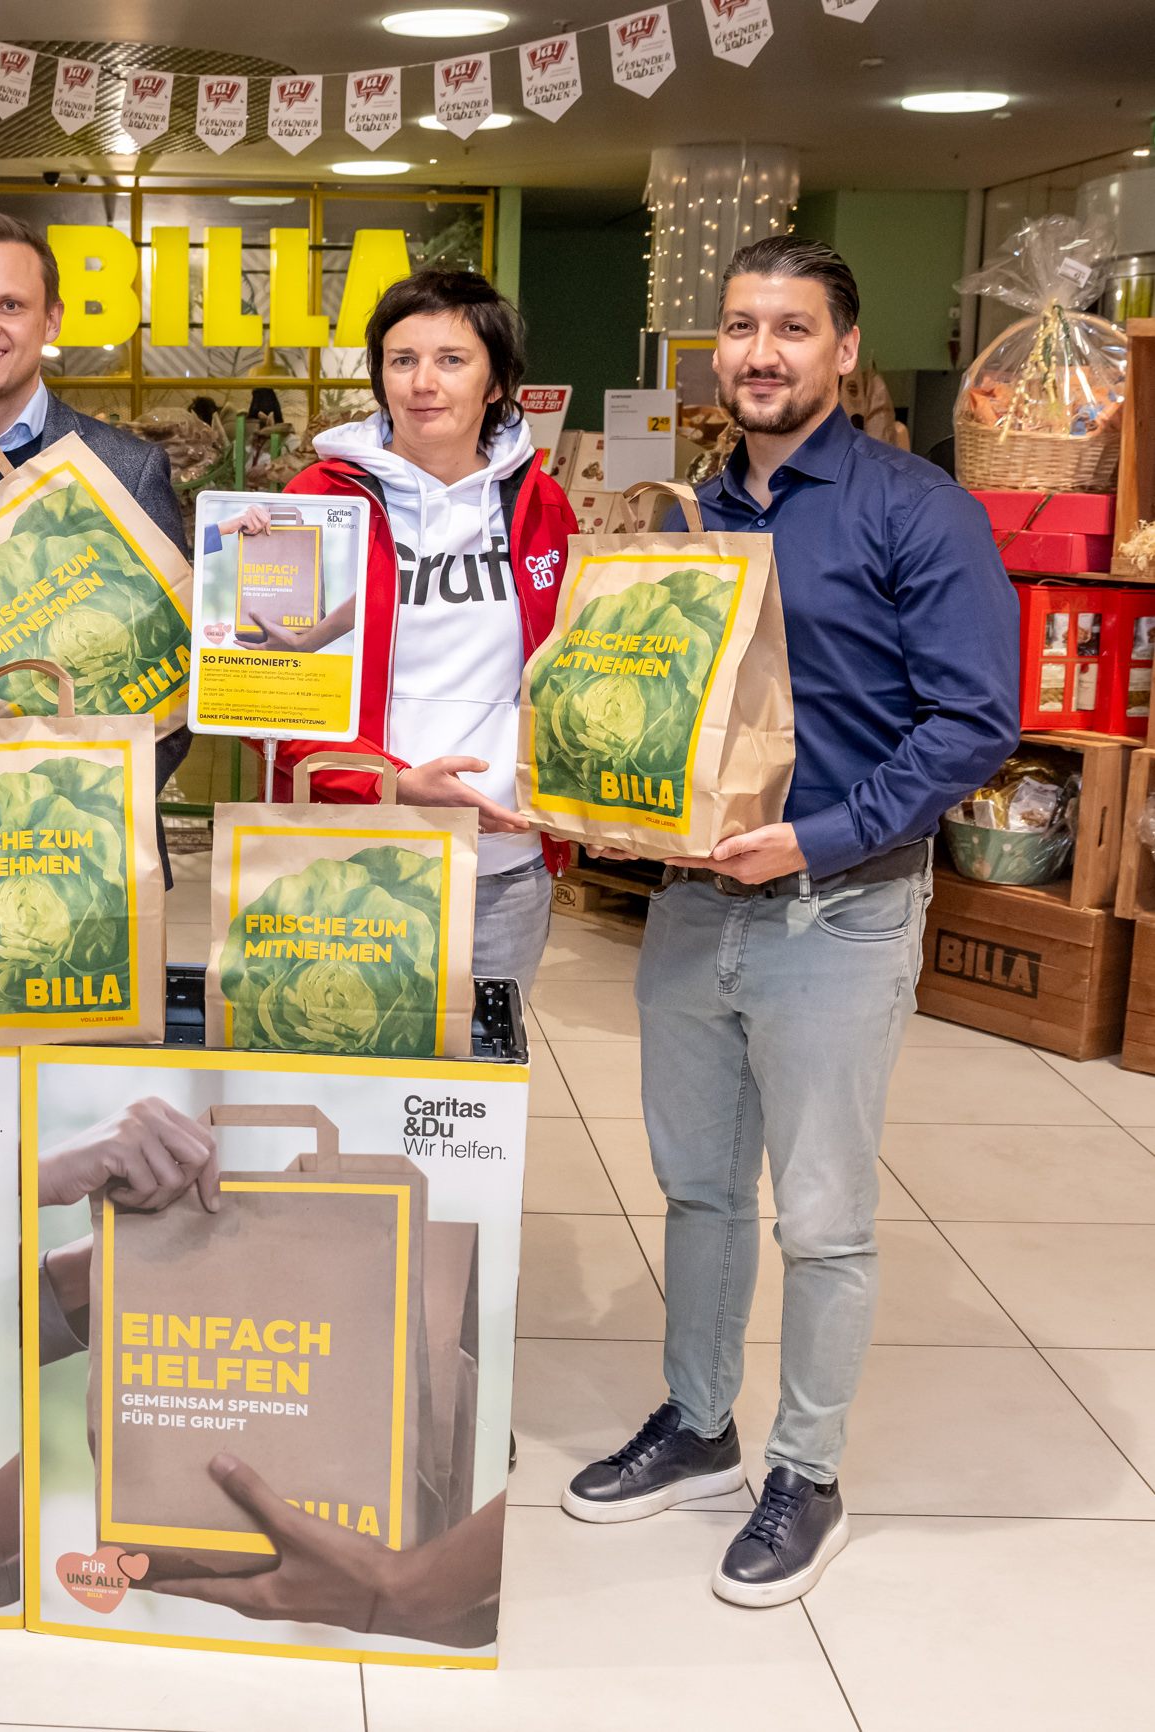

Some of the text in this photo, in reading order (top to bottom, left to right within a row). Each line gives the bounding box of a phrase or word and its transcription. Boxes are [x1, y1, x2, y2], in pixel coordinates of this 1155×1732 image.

[616, 52, 671, 73] GESUNDER
[626, 64, 664, 80] BODEN
[526, 78, 578, 98] GESUNDER
[535, 90, 570, 104] BODEN
[54, 99, 92, 112] GESUNDER
[438, 99, 489, 113] GESUNDER
[58, 108, 86, 120] BODEN
[124, 111, 166, 122] GESUNDER
[349, 112, 398, 123] GESUNDER
[447, 110, 481, 120] BODEN
[128, 121, 158, 130] BODEN
[199, 118, 244, 128] GESUNDER
[272, 118, 318, 128] GESUNDER
[356, 122, 391, 132] BODEN
[204, 127, 236, 136] BODEN
[278, 128, 310, 136] BODEN
[47, 224, 411, 348] BILLA
[527, 390, 558, 400] NUR FÜR
[544, 402, 562, 410] ZEIT
[52, 544, 100, 584] ZUM
[244, 564, 298, 575] EINFACH
[244, 574, 292, 586] HELFEN
[283, 616, 312, 626] BILLA
[566, 630, 690, 656] FRISCHE ZUM
[202, 656, 216, 664] SO
[553, 652, 671, 678] MITNEHMEN
[118, 644, 190, 713] BILLA
[600, 770, 675, 810] BILLA
[39, 829, 93, 849] ZUM
[246, 914, 407, 938] FRISCHE ZUM
[244, 940, 392, 964] MITNEHMEN
[939, 935, 1033, 992] BILLA
[25, 974, 122, 1008] BILLA
[404, 1094, 487, 1119] Caritas
[404, 1118, 454, 1139] &Du
[404, 1138, 506, 1160] Wir helfen.
[121, 1312, 331, 1356] EINFACH
[121, 1352, 310, 1395] HELFEN
[121, 1393, 308, 1417] GEMEINSAM SPENDEN
[121, 1408, 246, 1432] FÜR DIE GRUFT
[82, 1560, 106, 1574] FÜR
[67, 1573, 123, 1588] UNS ALLE
